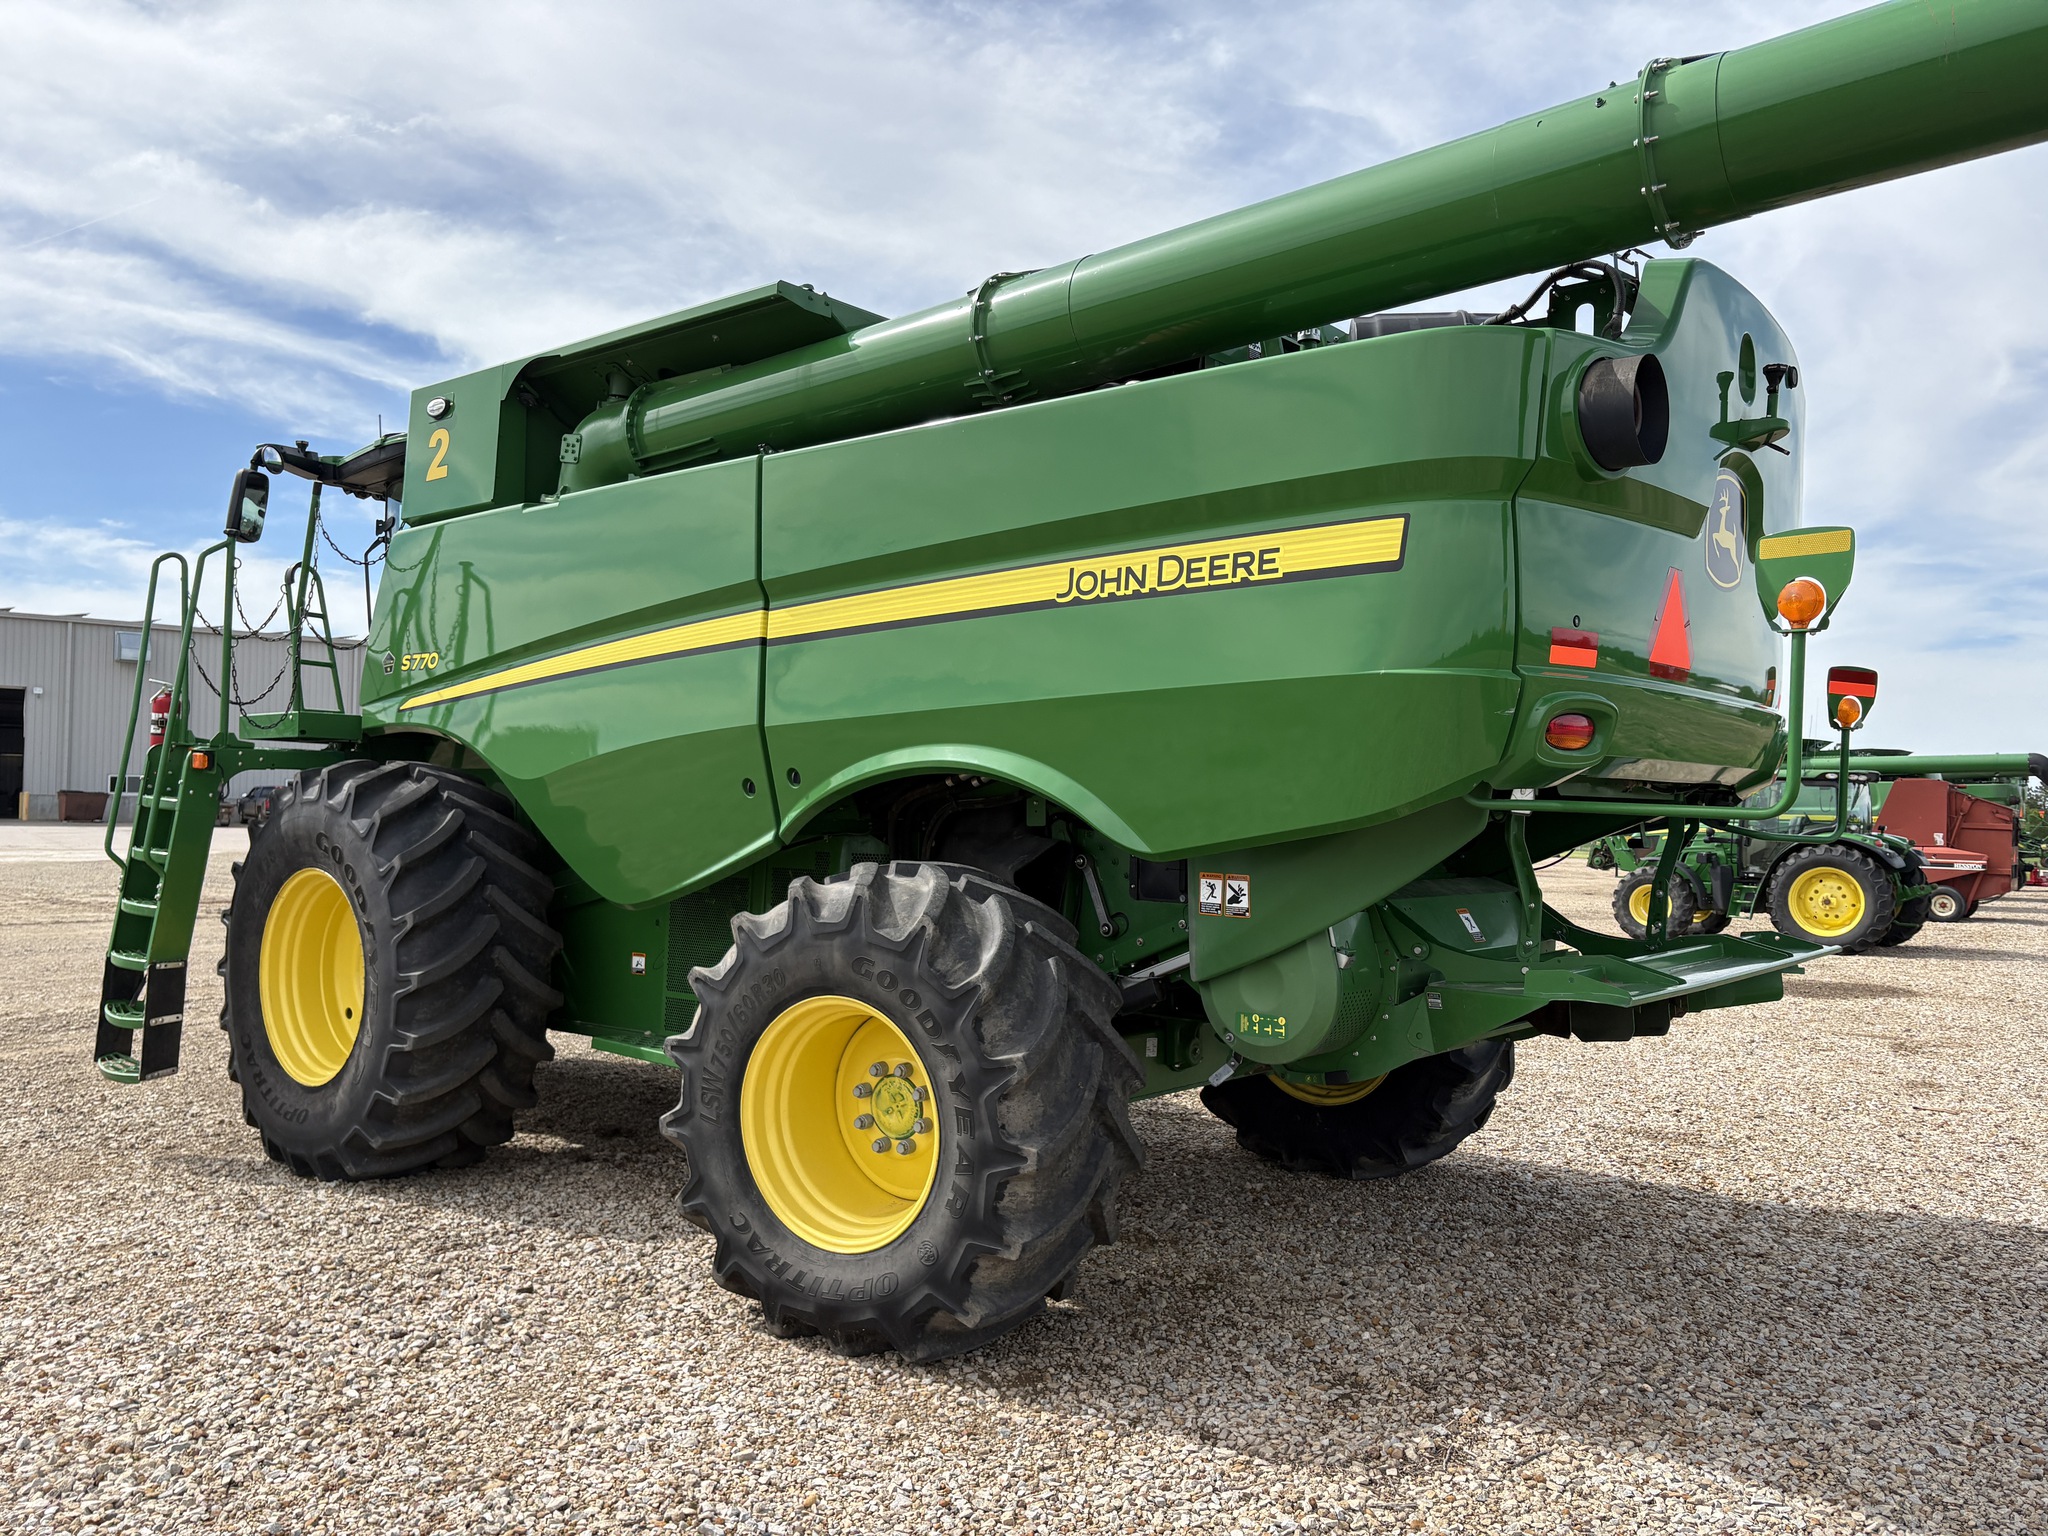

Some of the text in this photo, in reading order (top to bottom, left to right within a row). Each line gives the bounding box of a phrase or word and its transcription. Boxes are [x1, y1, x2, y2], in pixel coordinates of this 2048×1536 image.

[425, 428, 450, 482] 2
[1056, 547, 1281, 600] JOHN DEERE
[401, 651, 440, 671] S770
[241, 1033, 310, 1124] OPTITRAC
[852, 956, 976, 1219] GOODYEAR
[729, 1211, 899, 1302] OPTITRAC
